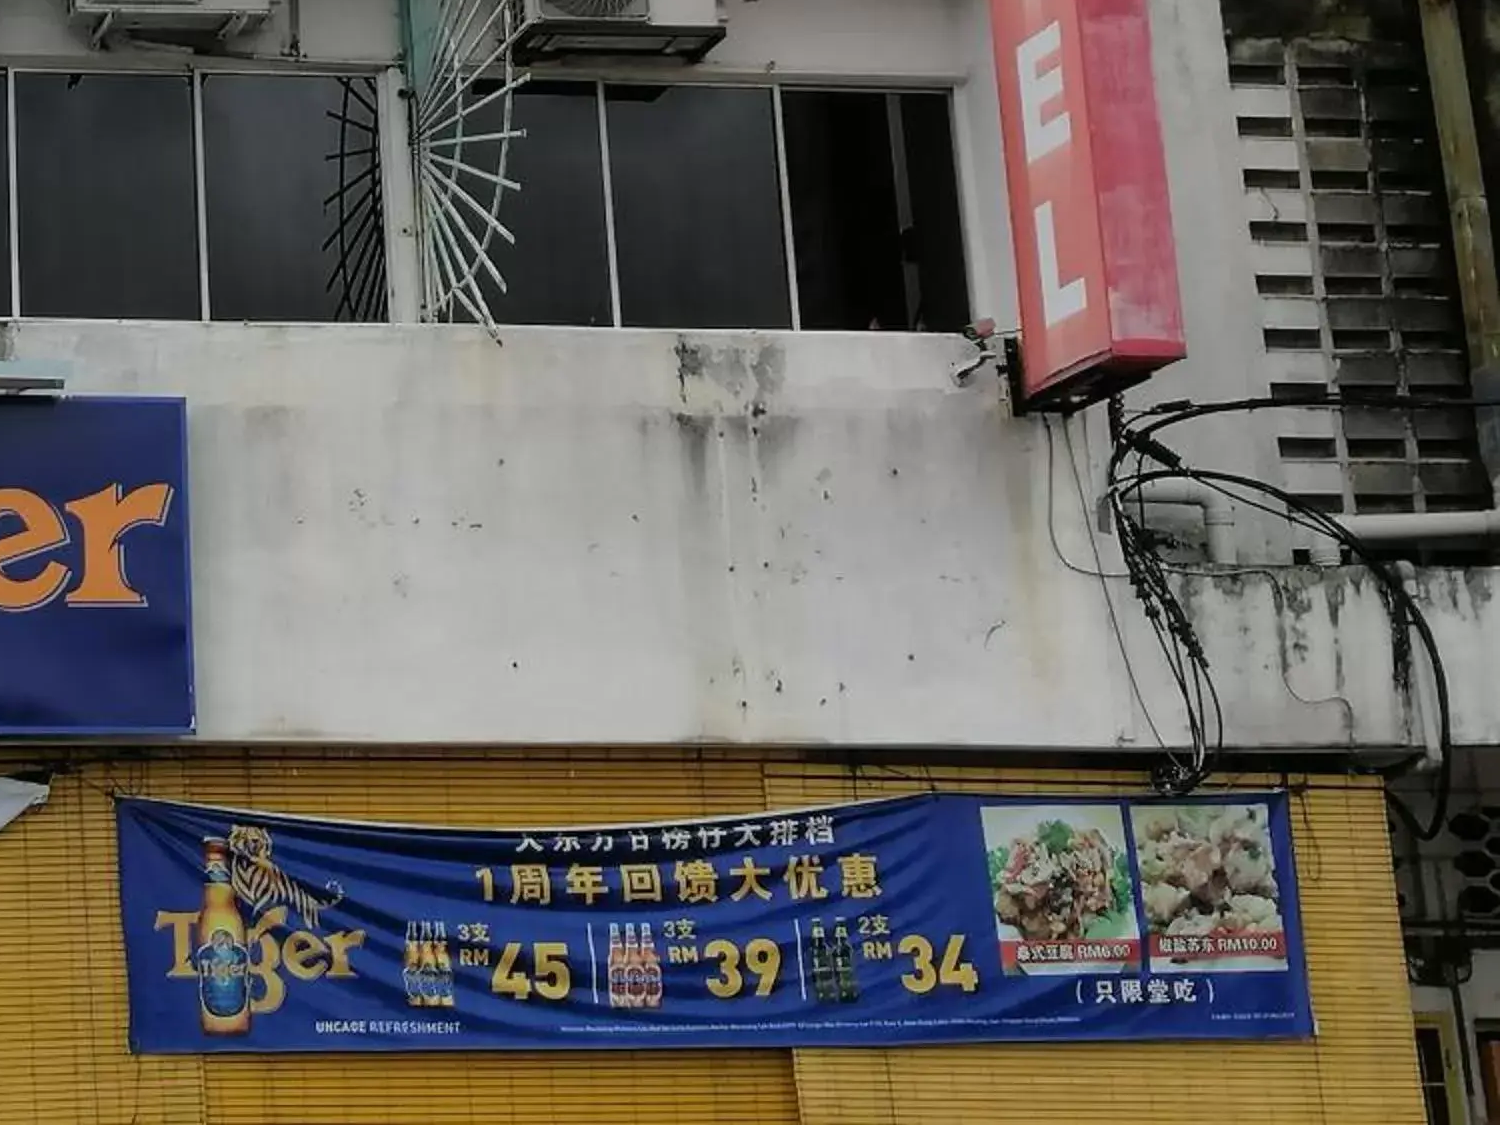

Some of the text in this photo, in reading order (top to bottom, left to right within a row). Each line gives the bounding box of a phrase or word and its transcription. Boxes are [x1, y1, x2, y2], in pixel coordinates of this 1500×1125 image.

[475, 852, 884, 906] 1周年回馈大优惠
[457, 921, 491, 943] 3支
[662, 917, 697, 941] 3支
[857, 913, 891, 936] 2支
[153, 906, 367, 1015] Tger
[458, 947, 490, 967] RM
[490, 941, 572, 1001] 45
[668, 938, 783, 999] RM 39
[862, 933, 980, 995] RM 34
